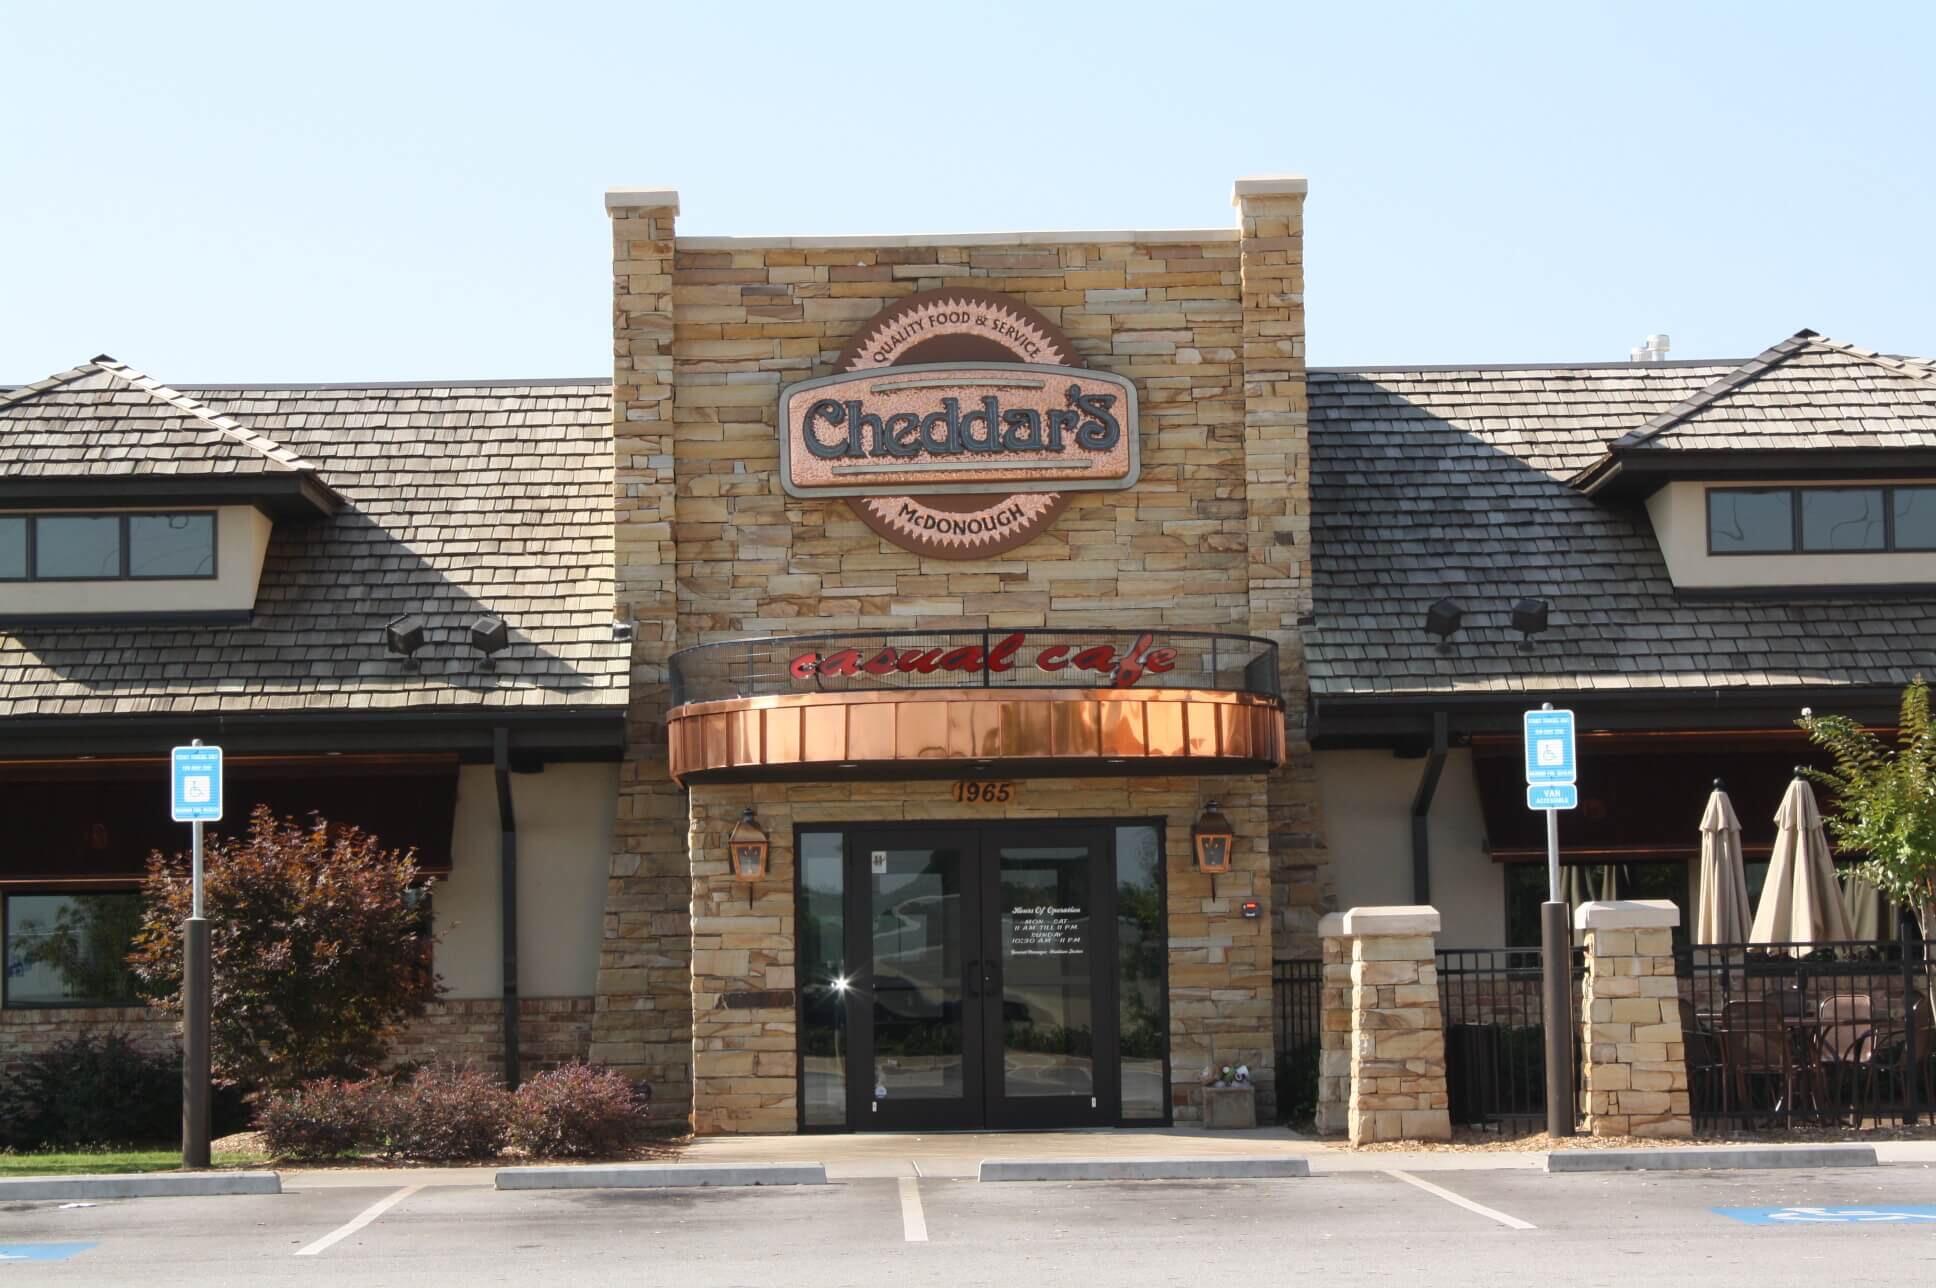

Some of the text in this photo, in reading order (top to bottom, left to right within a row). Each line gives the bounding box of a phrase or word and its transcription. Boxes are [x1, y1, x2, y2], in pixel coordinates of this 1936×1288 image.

[873, 311, 1041, 364] QUALITY FOOD & SERVICE
[898, 503, 1025, 536] McDONOUGH
[790, 631, 1026, 680] casual
[956, 783, 1011, 802] 1965
